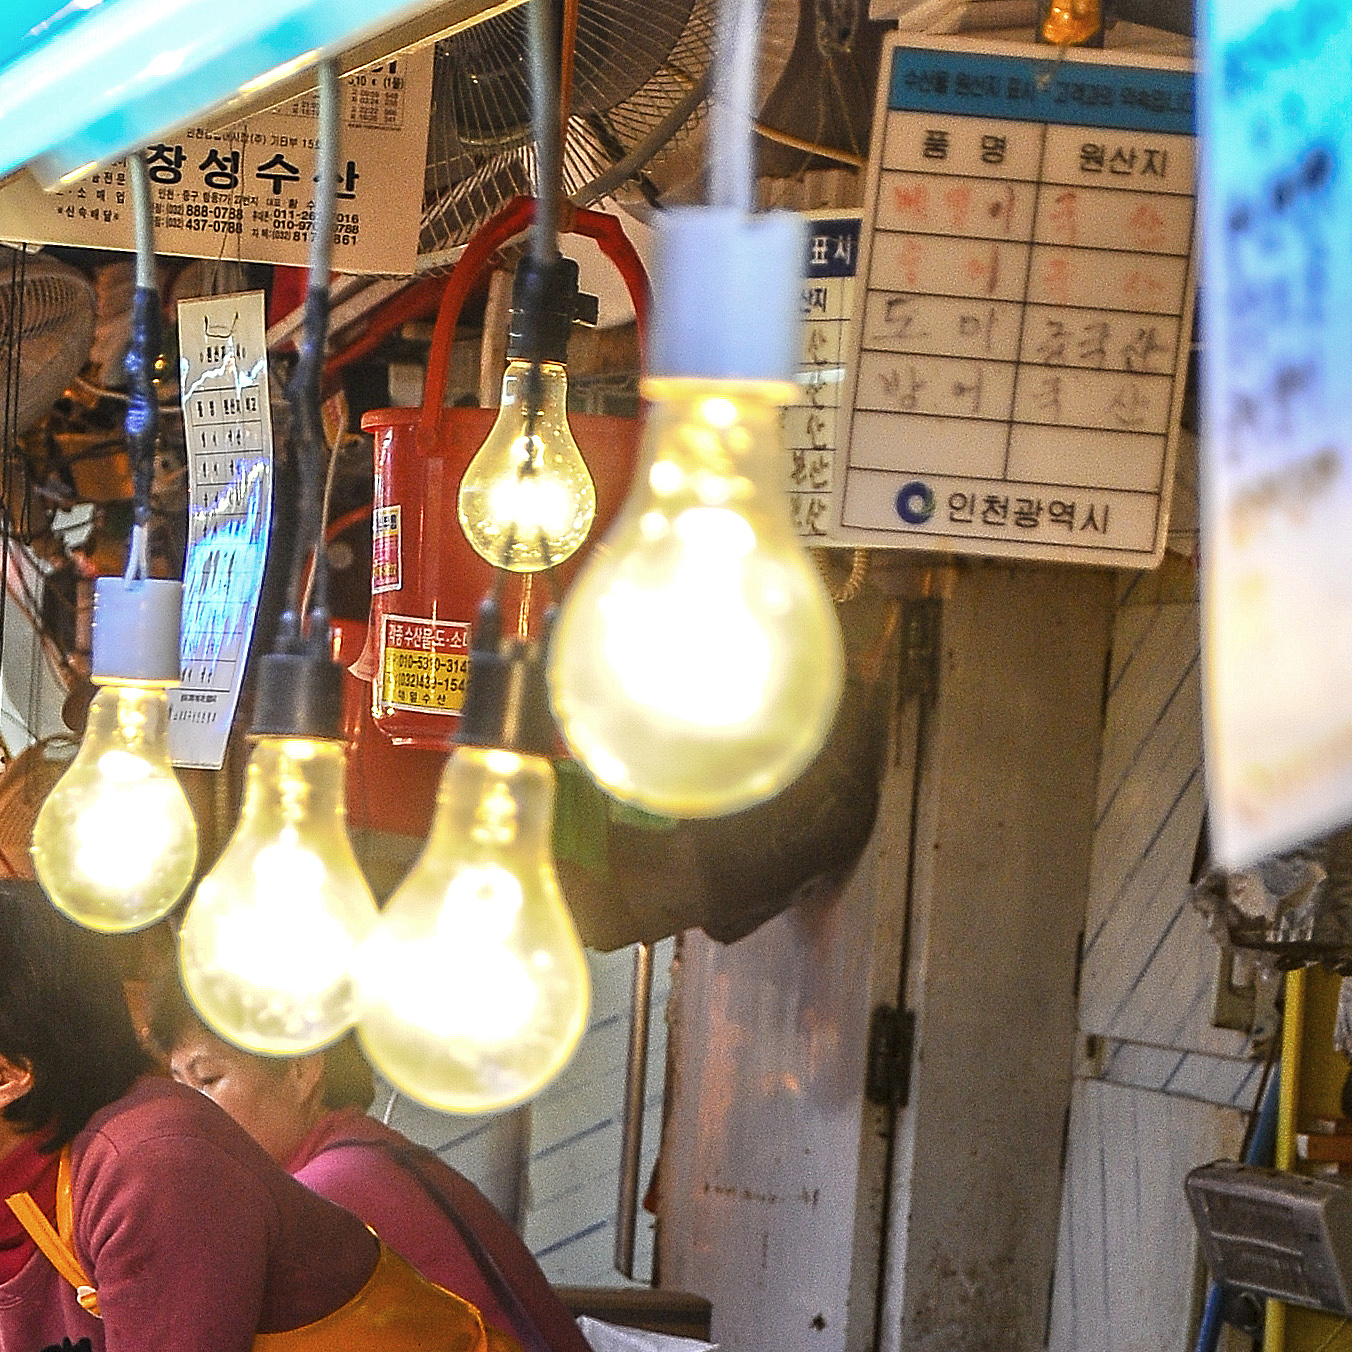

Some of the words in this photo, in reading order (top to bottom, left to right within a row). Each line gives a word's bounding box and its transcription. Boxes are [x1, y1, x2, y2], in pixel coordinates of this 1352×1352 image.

[1080, 143, 1166, 177] 원산지
[810, 235, 852, 265] 표시
[948, 491, 1110, 534] 인천광역시
